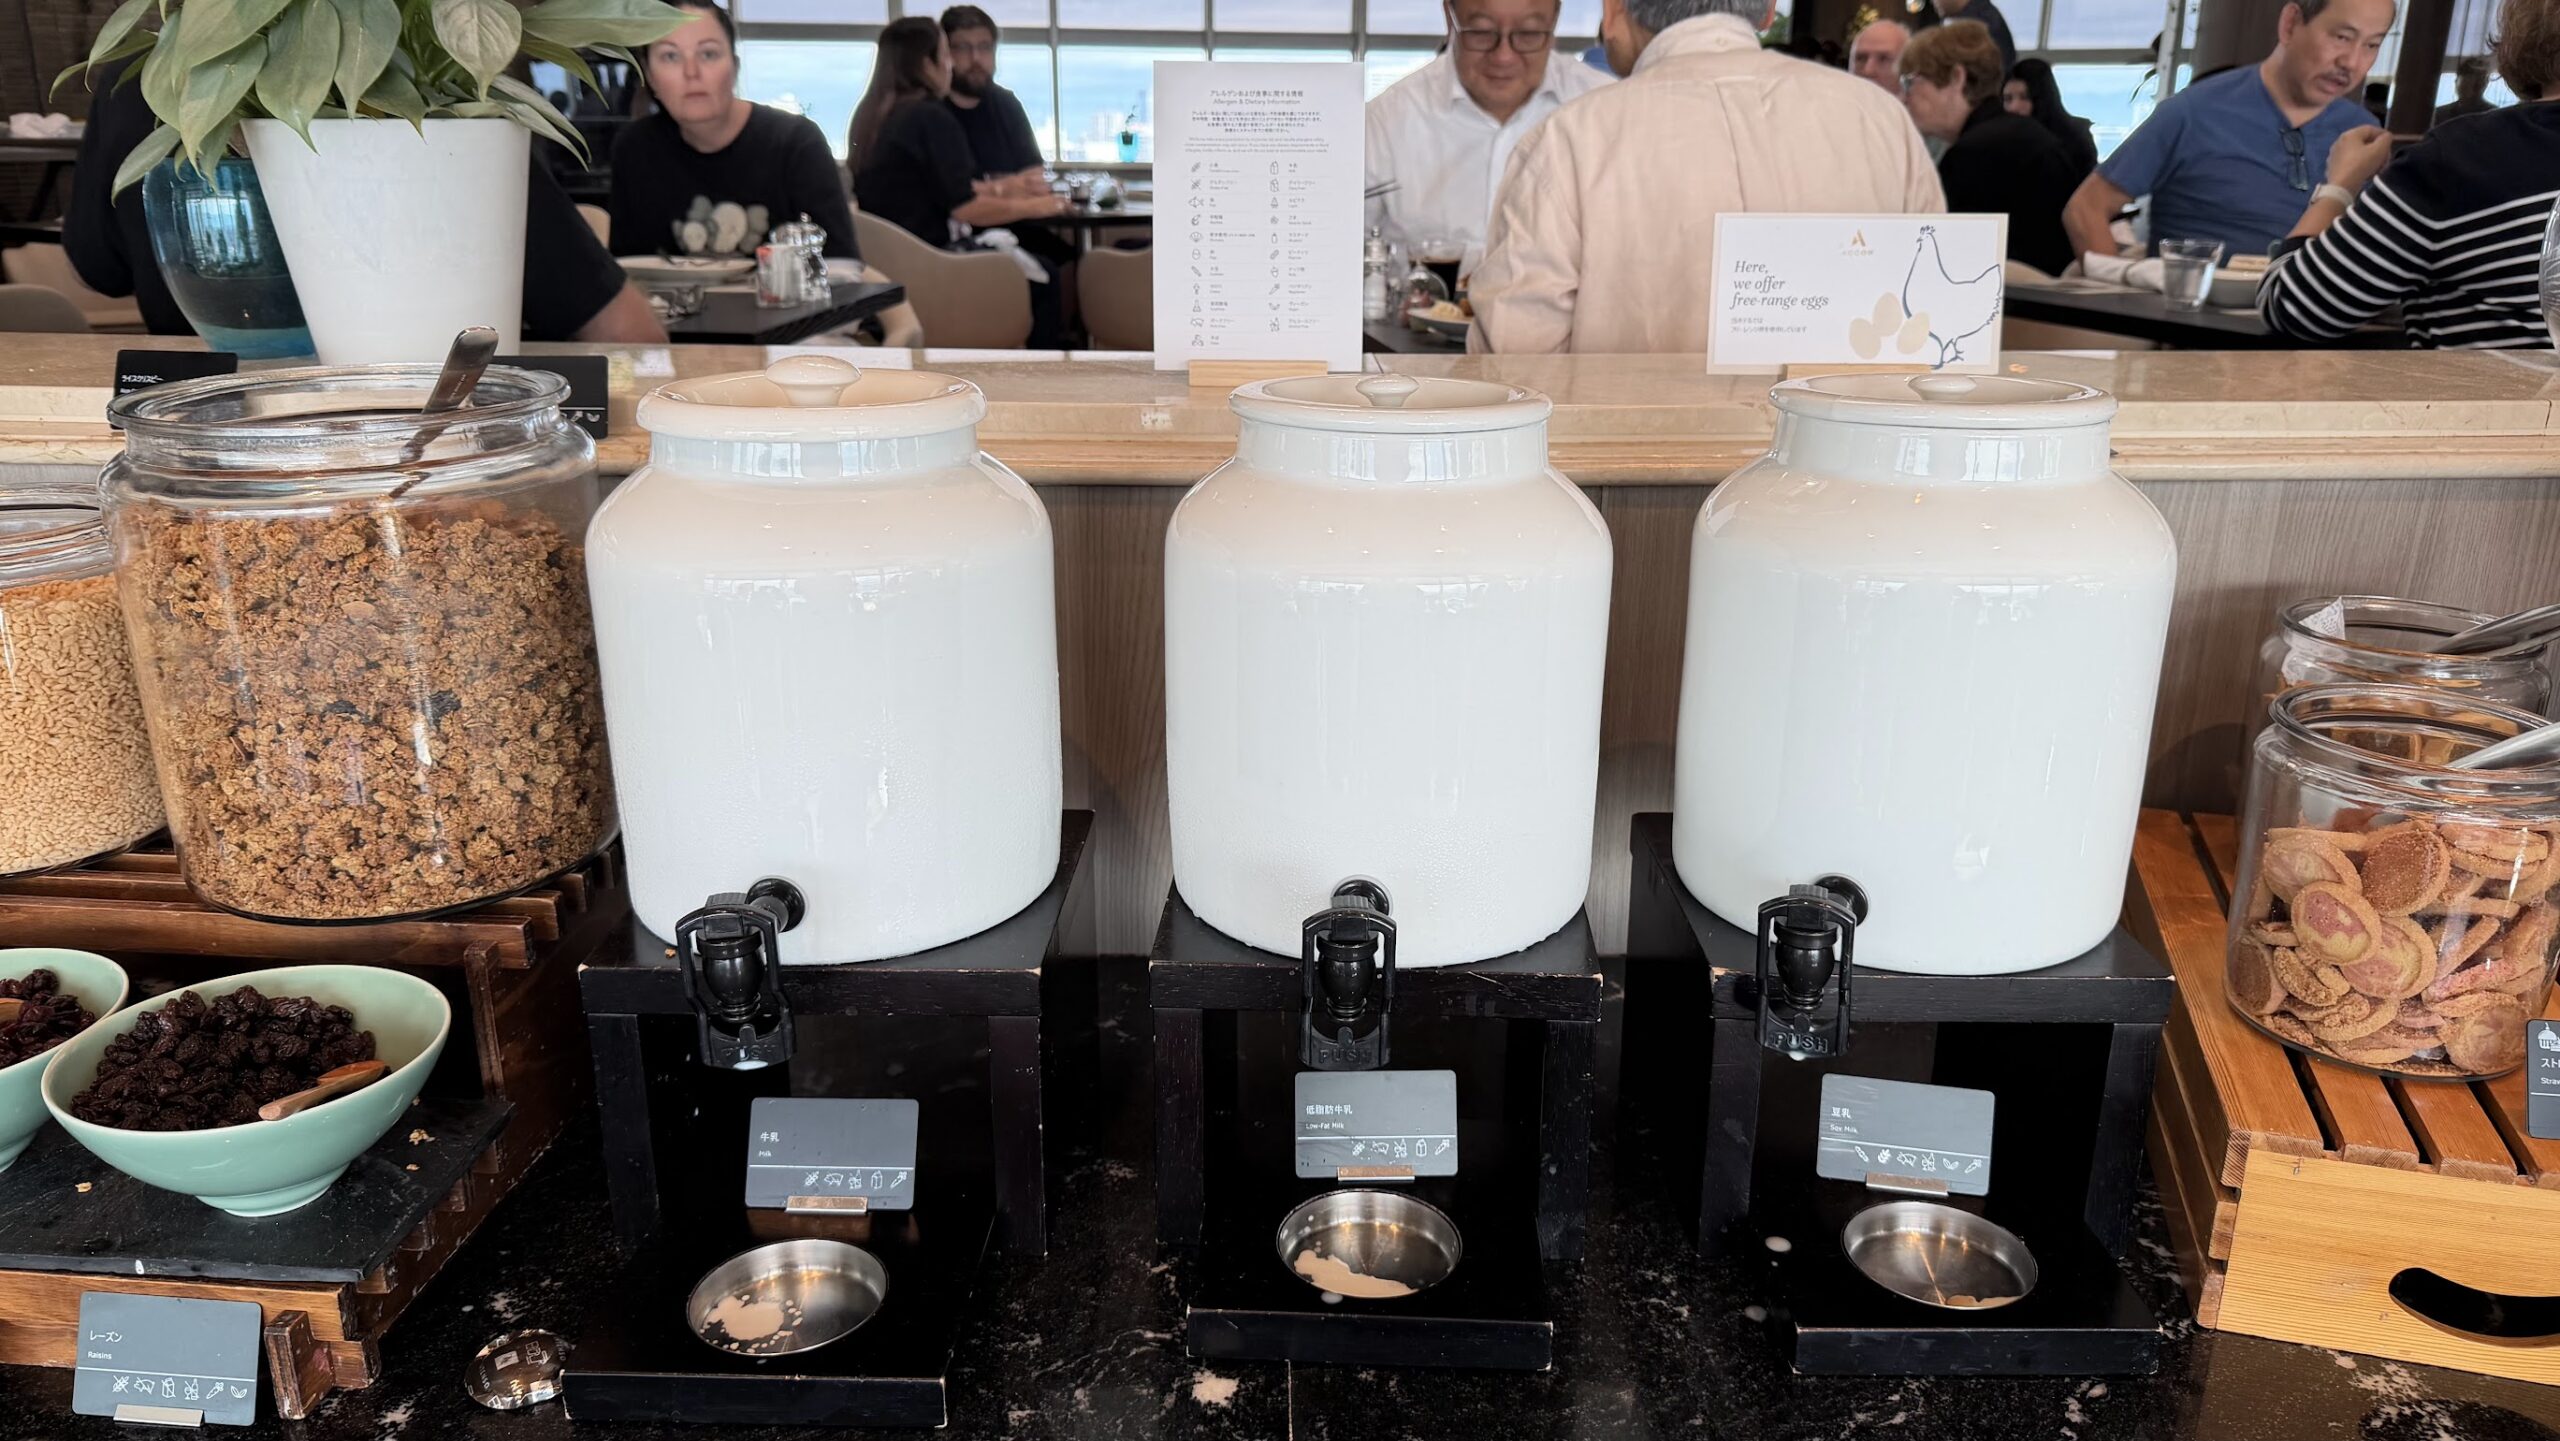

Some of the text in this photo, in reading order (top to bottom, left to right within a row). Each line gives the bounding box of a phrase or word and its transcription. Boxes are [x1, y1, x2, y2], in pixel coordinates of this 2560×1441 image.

[1734, 260, 1769, 275] Here,
[1733, 275, 1786, 294] we offer
[1730, 292, 1829, 310] free-range eggs
[1772, 1032, 1828, 1053] PUSH
[1319, 1048, 1372, 1064] PUSH
[2541, 1058, 2560, 1068] スト
[1306, 1104, 1353, 1115] 低脂肪牛乳
[1831, 1106, 1852, 1119] 豆乳
[1305, 1122, 1330, 1130] Low-Fat
[1830, 1124, 1858, 1134] Soy Milk
[760, 1132, 780, 1142] 牛乳
[90, 1330, 122, 1343] レーズン
[88, 1351, 112, 1360] Raisins
